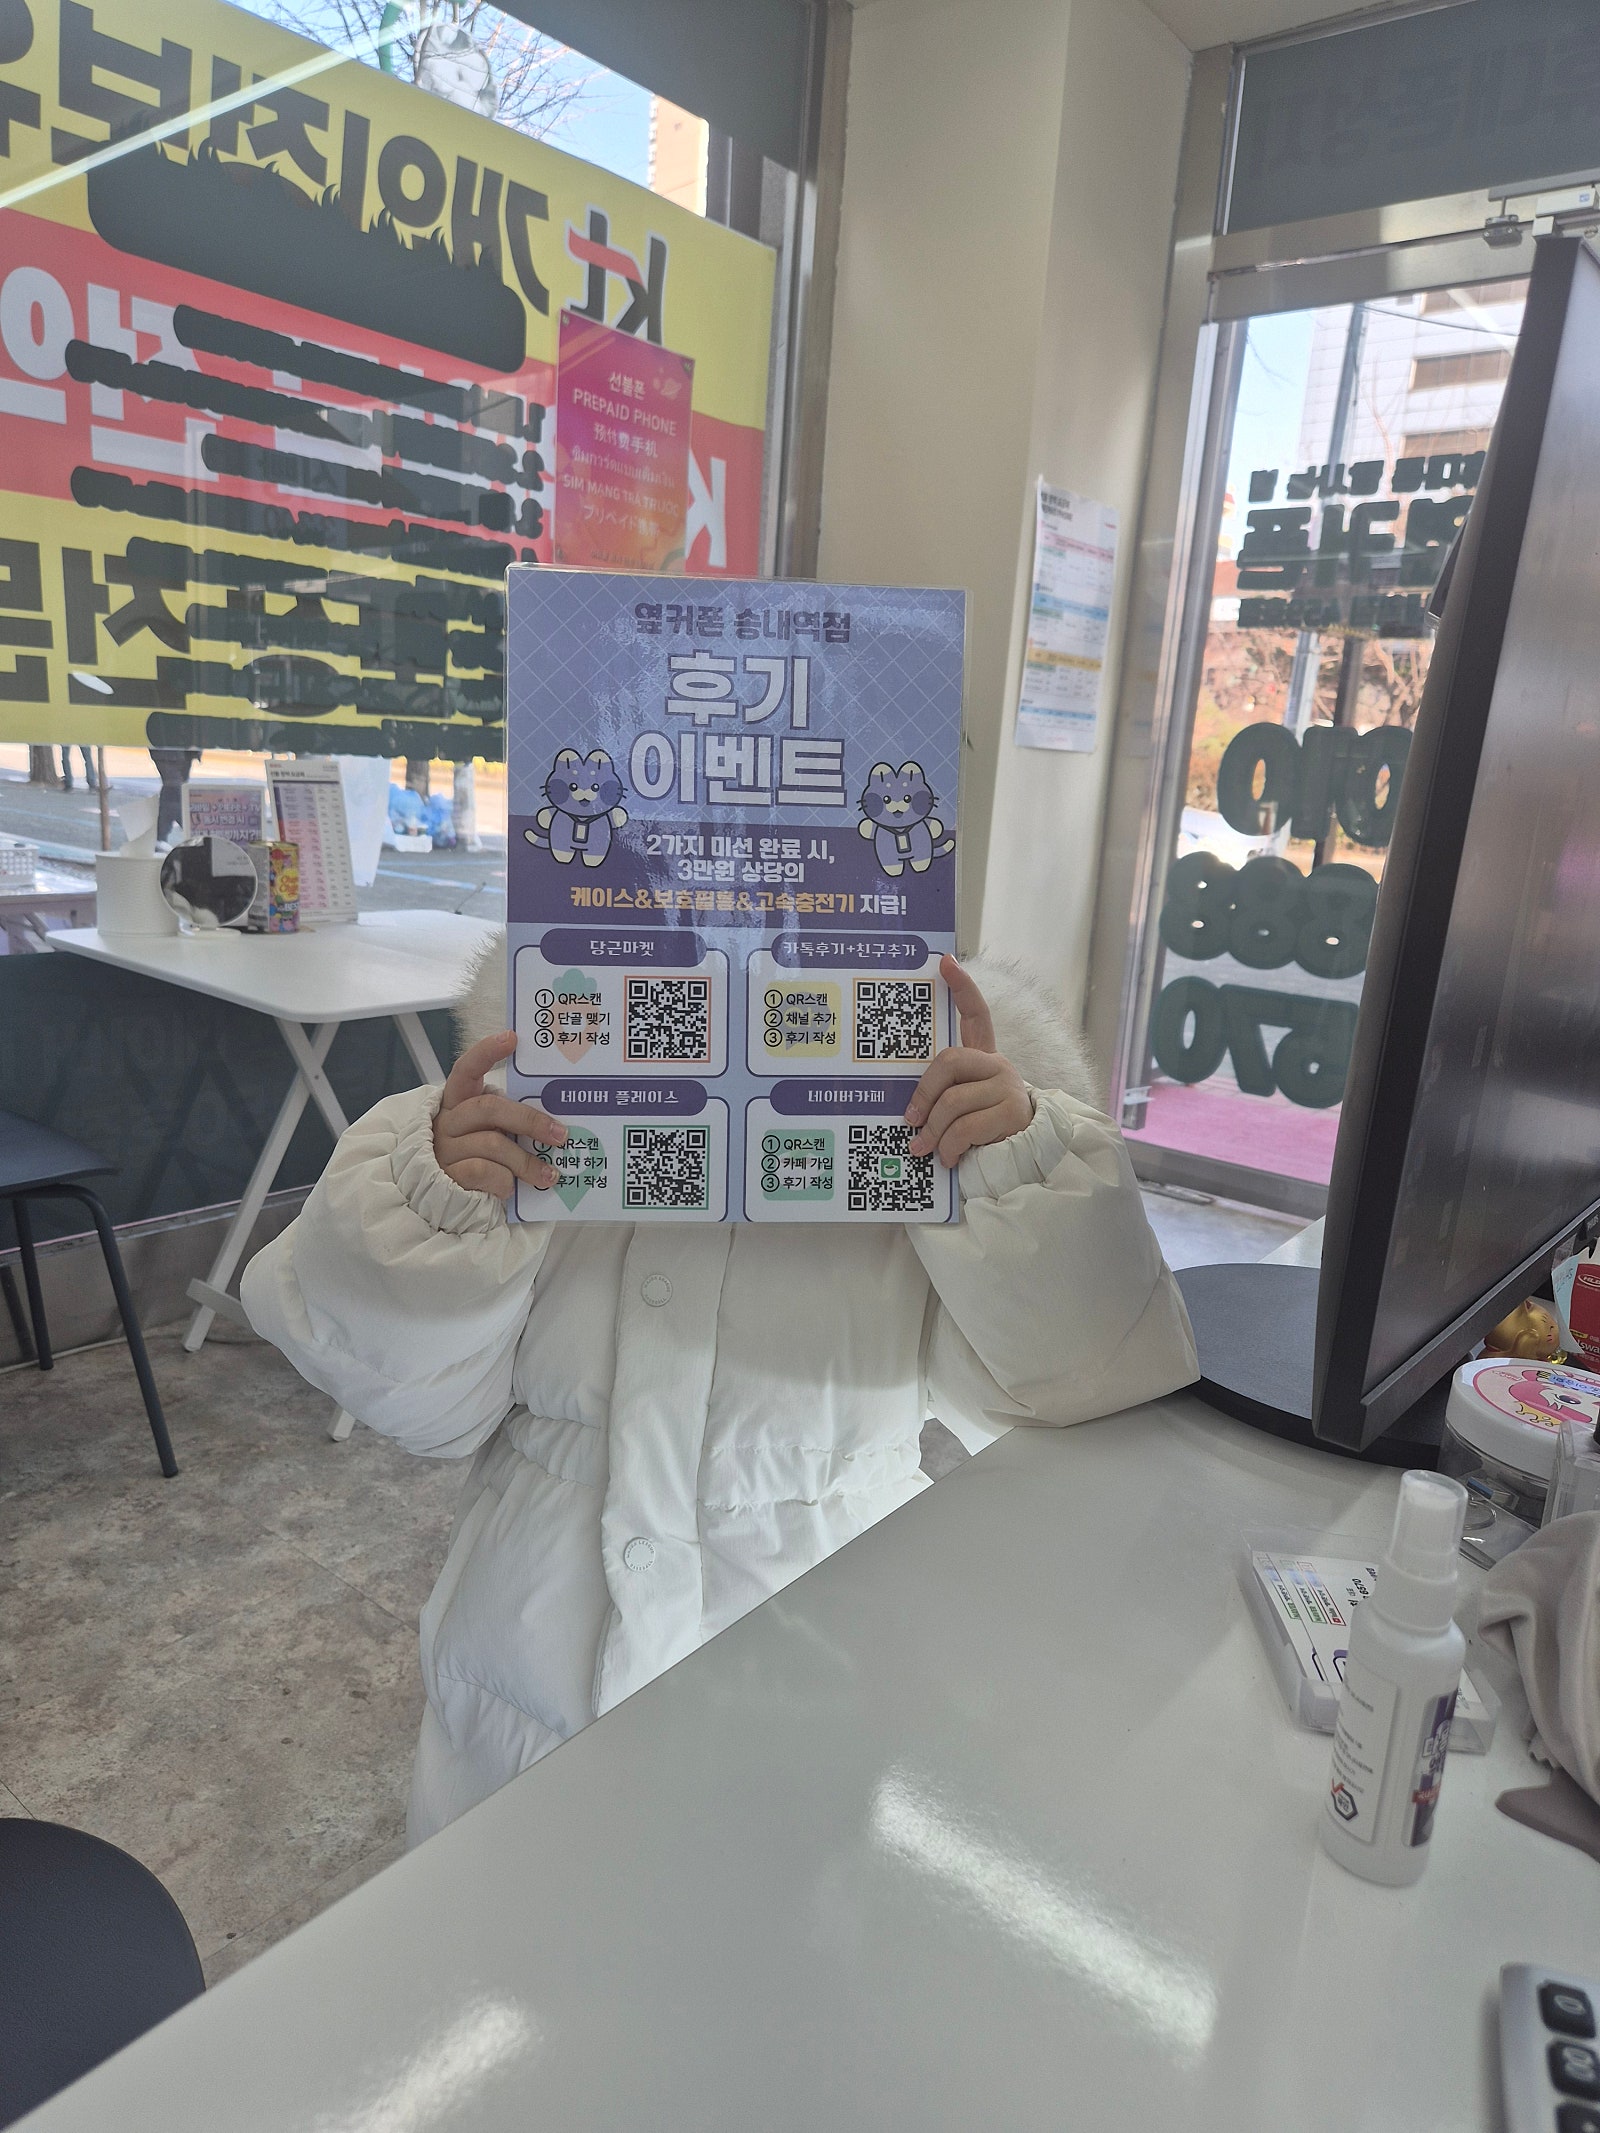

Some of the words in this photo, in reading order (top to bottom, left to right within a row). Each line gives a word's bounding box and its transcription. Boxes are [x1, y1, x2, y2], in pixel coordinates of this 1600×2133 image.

[608, 371, 646, 401] 선불폰
[573, 387, 630, 421] PREPAID
[633, 407, 677, 437] PHONE
[563, 474, 584, 491] SIM
[635, 602, 724, 638] 옆커폰
[734, 608, 850, 643] 송내역점
[665, 649, 811, 730] 후기
[629, 731, 847, 808] 이벤트
[647, 834, 705, 856] 2가지
[712, 836, 753, 859] 미션
[759, 837, 801, 860] 완료
[807, 839, 834, 864] 시,
[678, 859, 734, 881] 3만원
[742, 861, 804, 883] 상당의
[571, 886, 855, 914] 케이스&보호필름&고속충전기
[860, 894, 906, 915] 지급!
[590, 940, 654, 957] 당근마켓
[783, 942, 917, 958] 카톡후기+친구추가
[558, 993, 602, 1006] QR스캔
[786, 993, 828, 1006] QR스캔
[558, 1012, 582, 1026] 단골
[586, 1012, 610, 1026] 맺기
[786, 1012, 809, 1026] 채널
[813, 1012, 836, 1026] 추가
[558, 1032, 582, 1045] 후기
[586, 1032, 610, 1045] 작성
[786, 1031, 809, 1045] 후기
[813, 1031, 836, 1045] 작성
[560, 1090, 609, 1103] 네이버
[615, 1090, 679, 1106] 플레이스
[808, 1090, 885, 1103] 네이버카페
[784, 1138, 825, 1151] QR스캔
[556, 1157, 580, 1170] 예약
[584, 1157, 608, 1170] 하기
[783, 1157, 807, 1170] 카페
[810, 1157, 833, 1171] 가입
[556, 1175, 580, 1188] 후기
[584, 1176, 608, 1189] 작성
[783, 1177, 806, 1190] 후기
[810, 1177, 833, 1190] 작성
